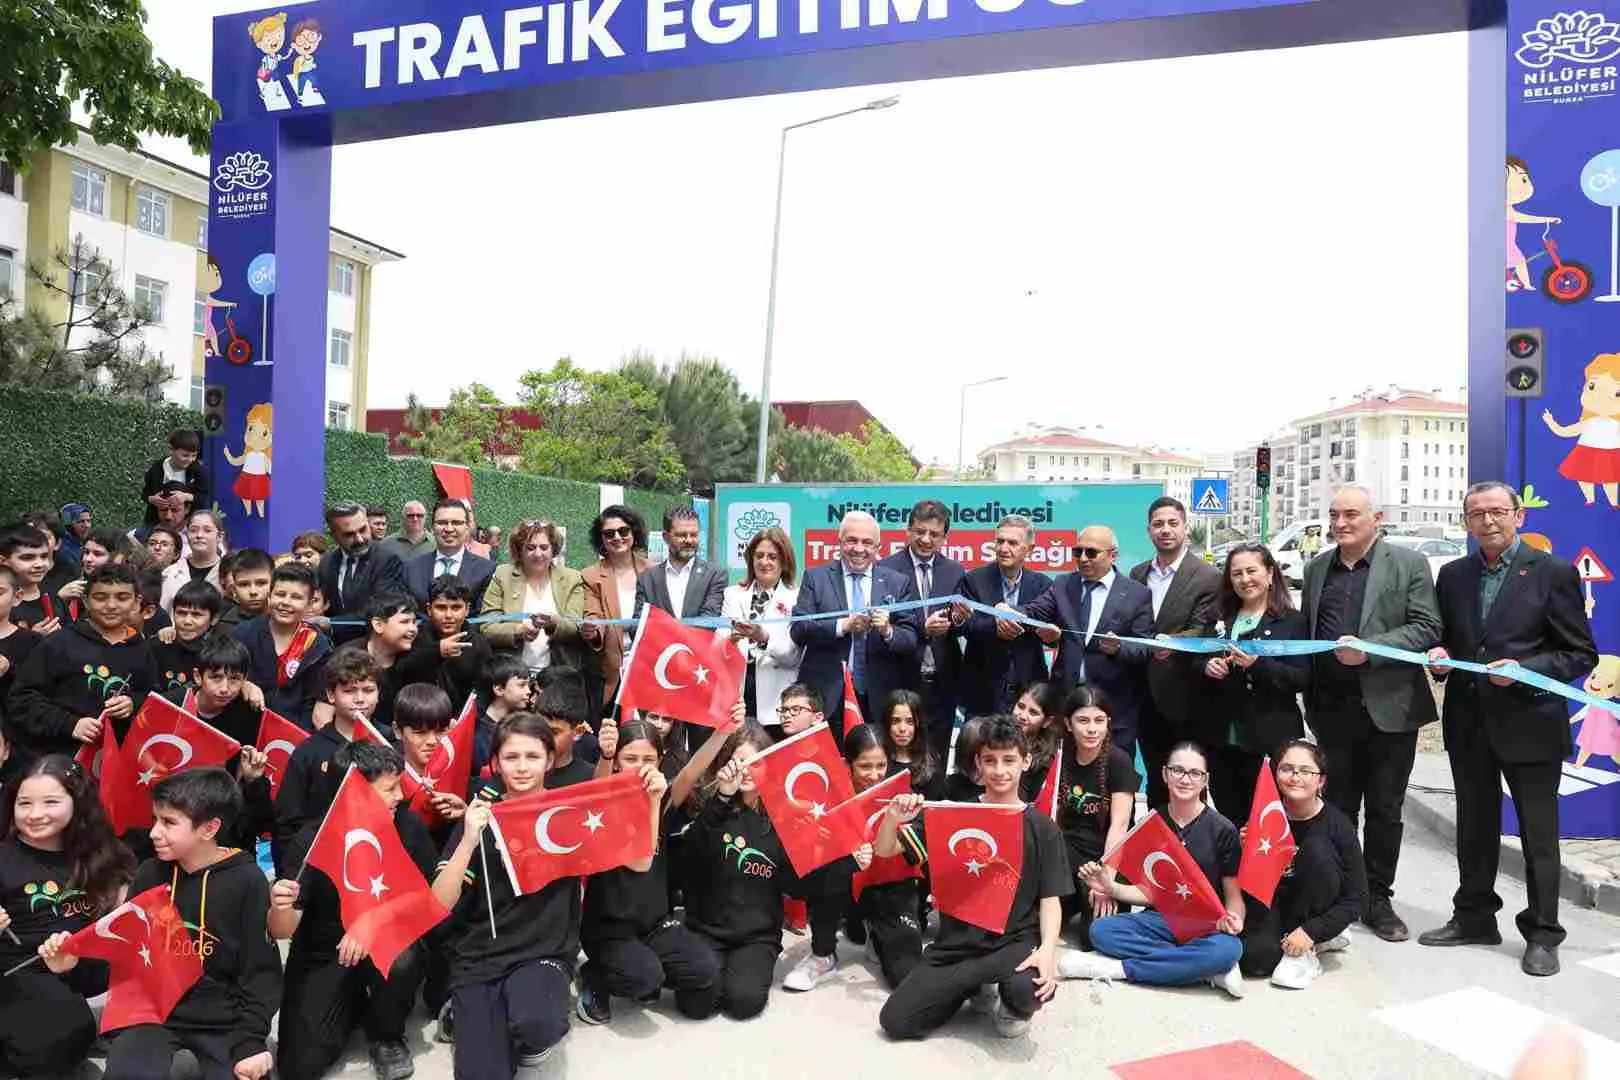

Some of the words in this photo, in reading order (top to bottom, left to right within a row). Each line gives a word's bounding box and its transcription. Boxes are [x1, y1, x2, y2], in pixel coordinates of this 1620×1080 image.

[1524, 66, 1618, 84] NİLÜFER
[1523, 80, 1616, 97] BELEDİYESİ
[981, 539, 1073, 567] Sağı
[743, 861, 774, 879] 2006
